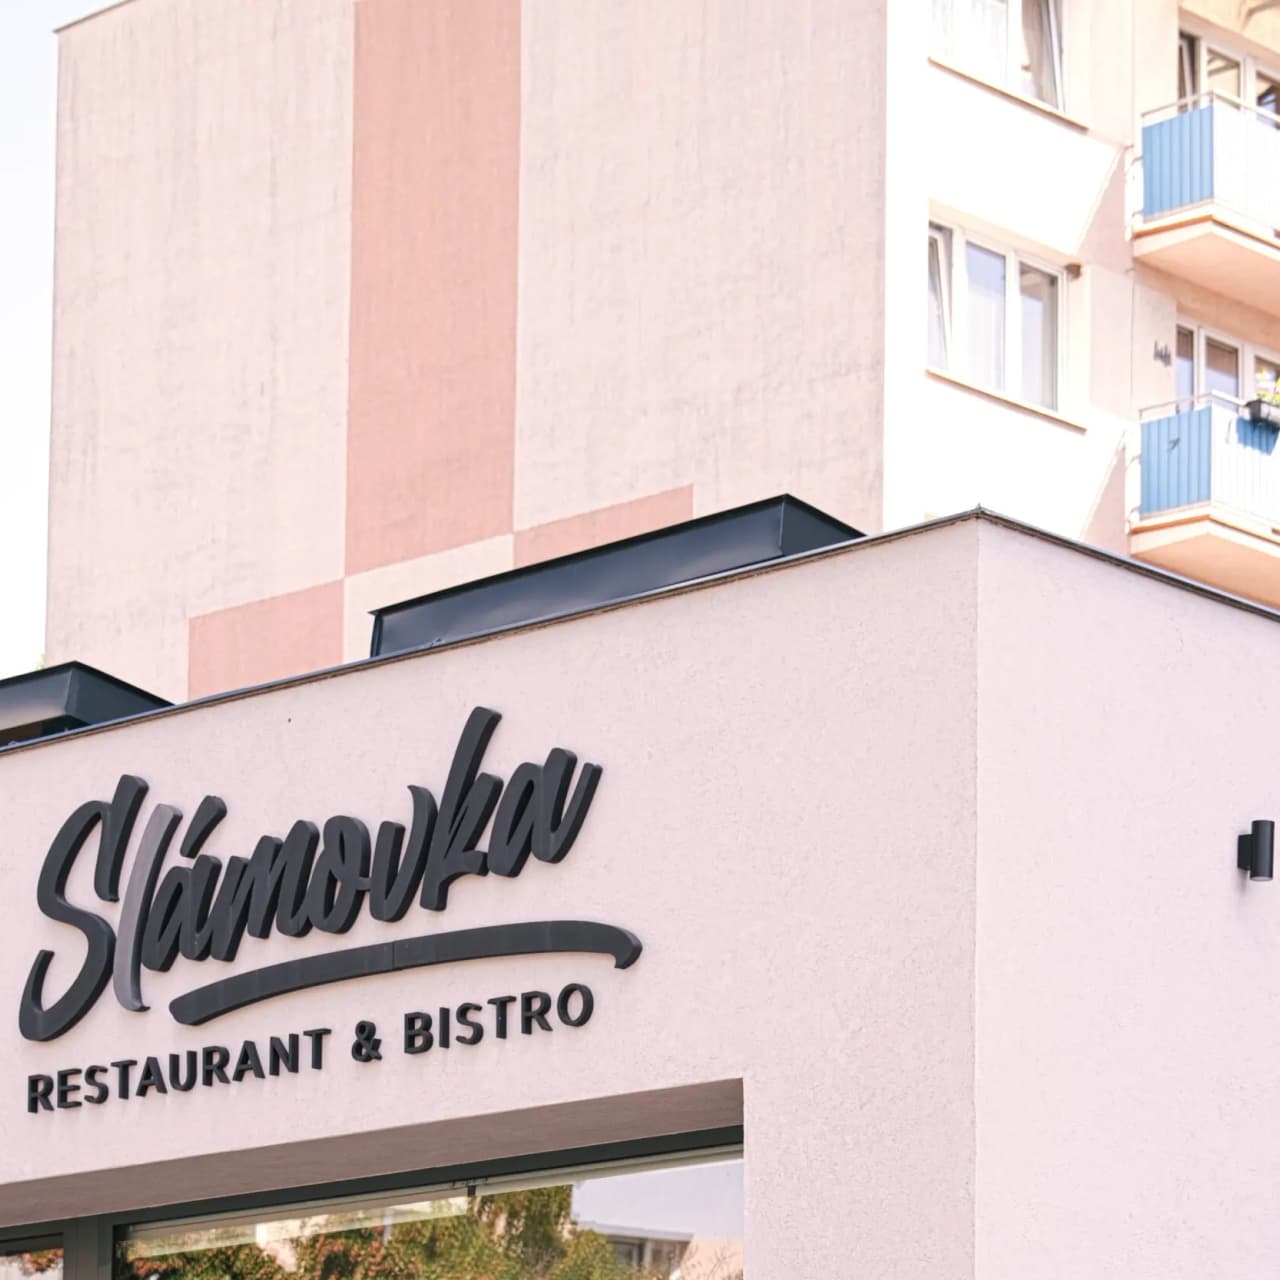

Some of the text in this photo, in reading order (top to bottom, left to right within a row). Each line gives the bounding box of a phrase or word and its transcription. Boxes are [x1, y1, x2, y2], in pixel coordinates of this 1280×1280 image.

[19, 706, 603, 1042] Slámovka
[27, 983, 595, 1114] RESTAURANT & BISTRO
